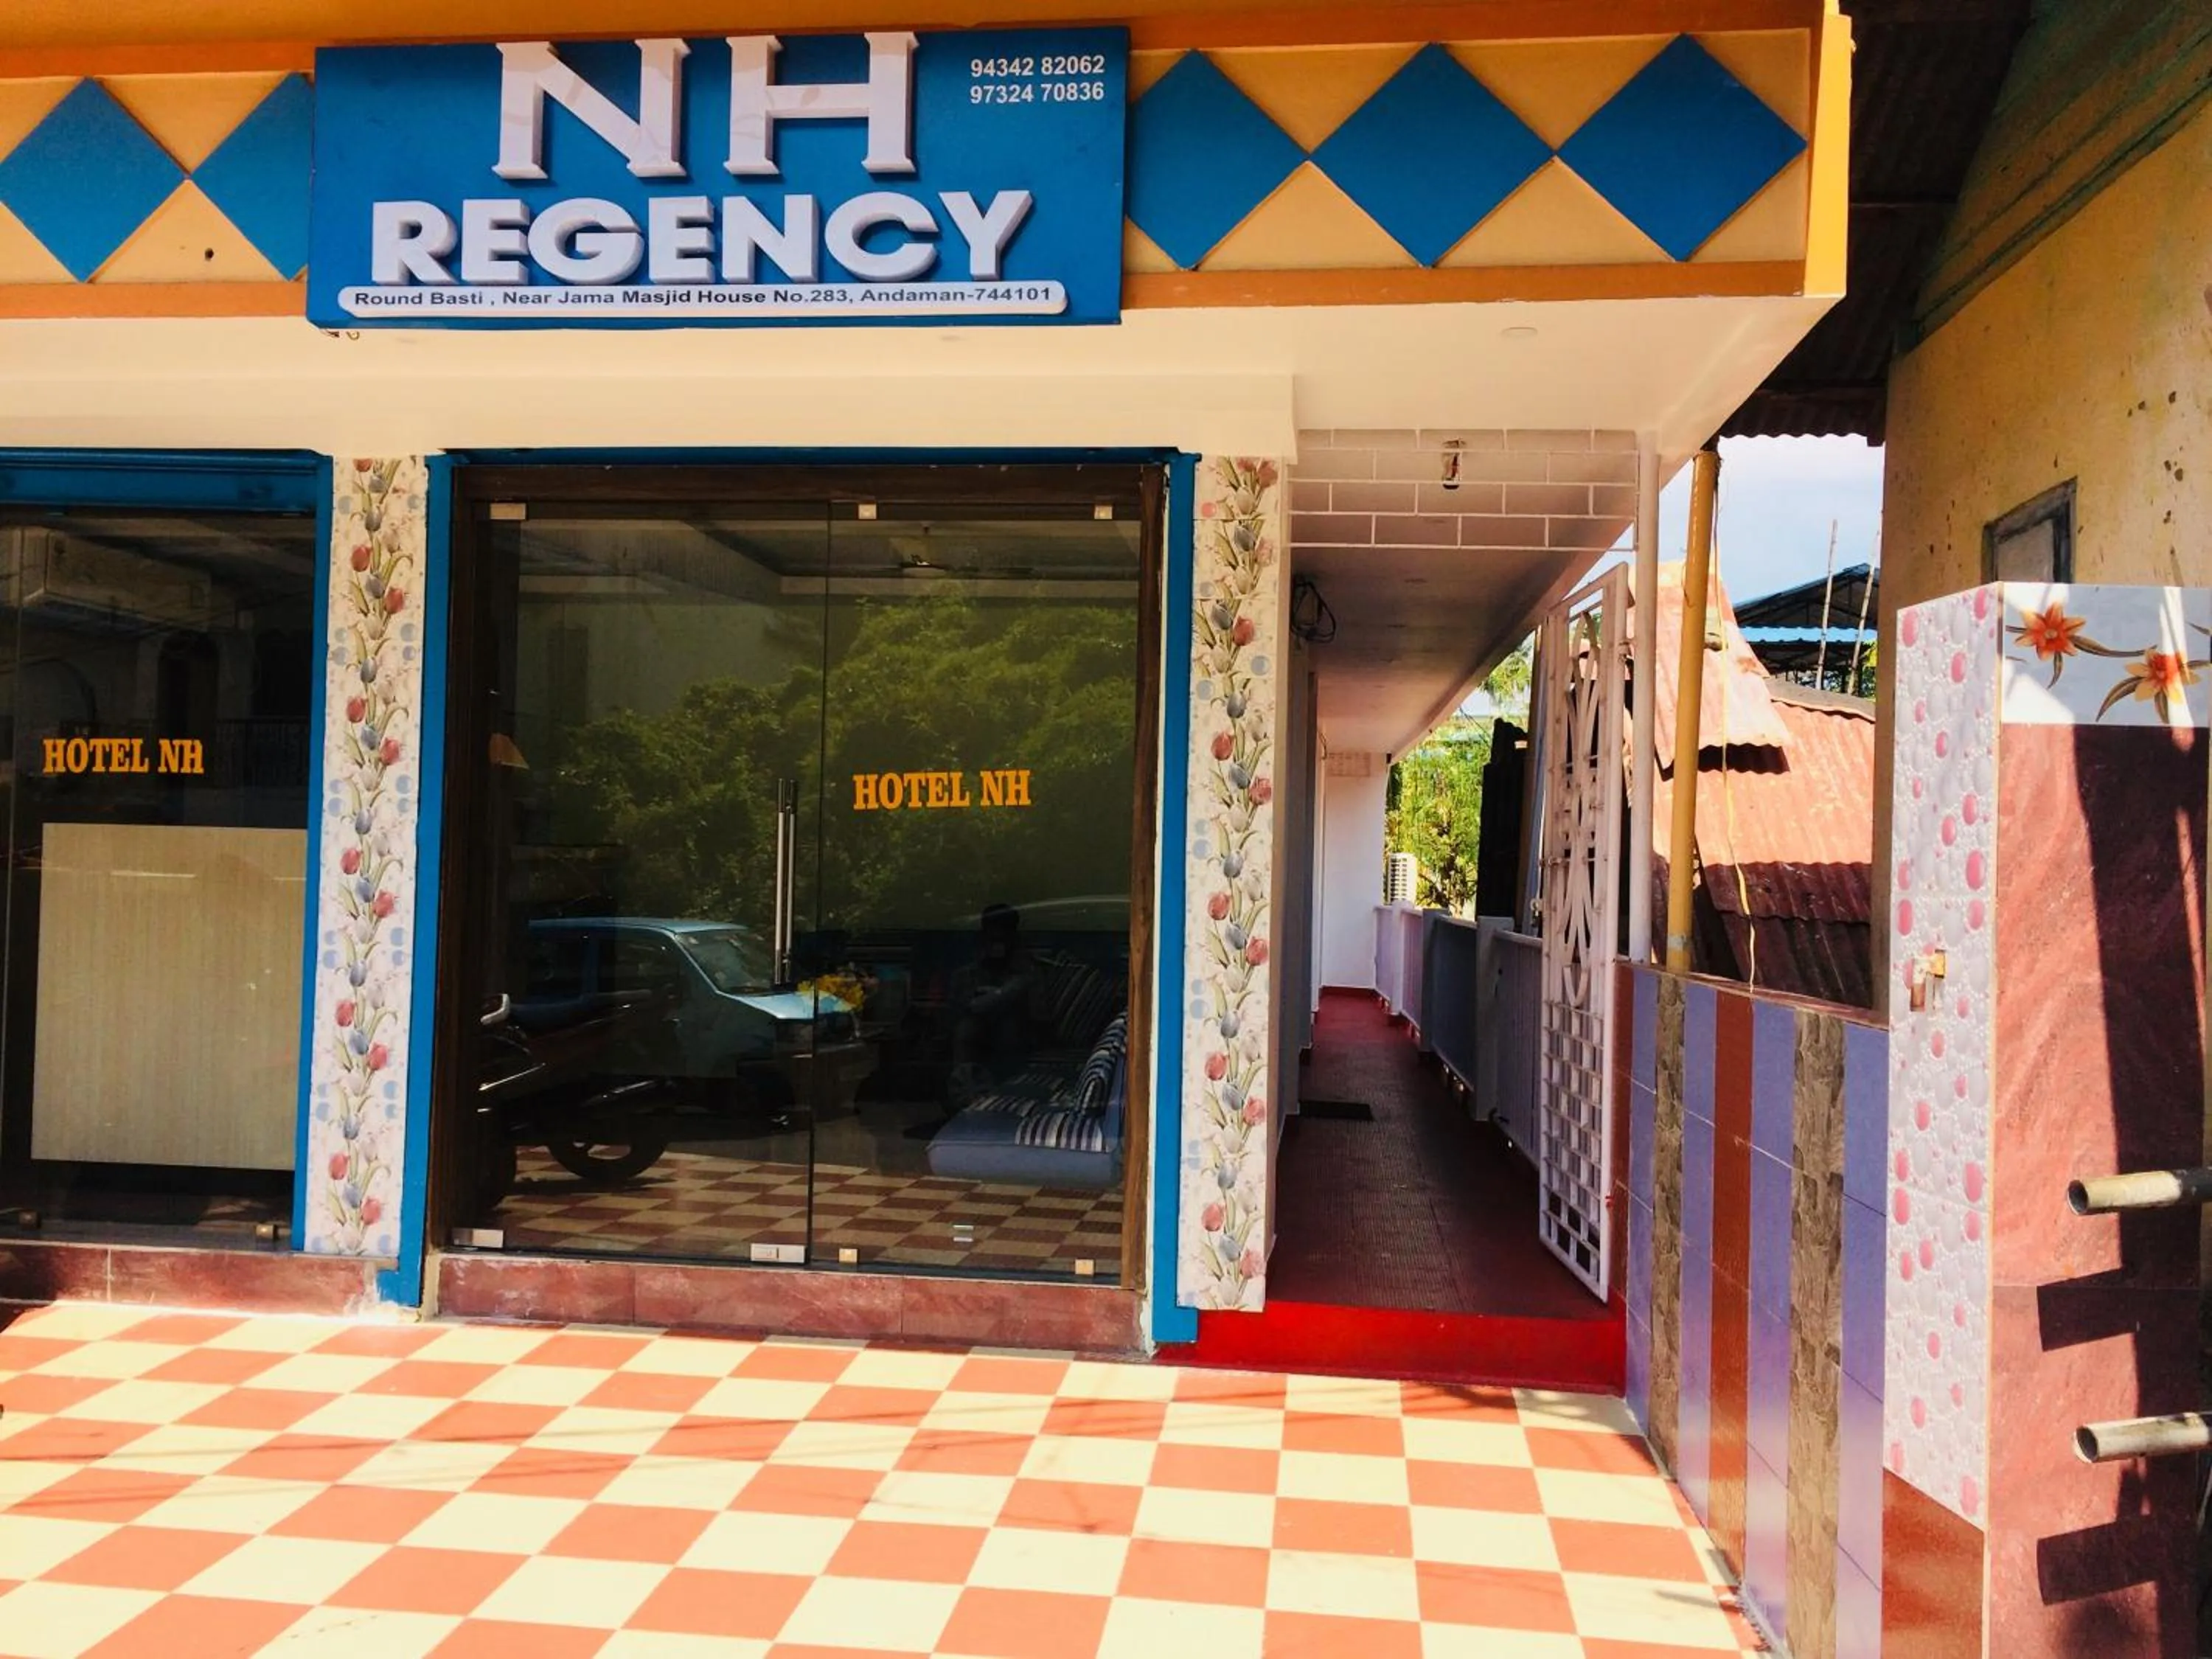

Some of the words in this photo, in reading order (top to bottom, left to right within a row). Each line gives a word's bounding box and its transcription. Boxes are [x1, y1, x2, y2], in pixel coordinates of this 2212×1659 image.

[970, 57, 1034, 77] 94342
[1040, 55, 1105, 75] 82062
[492, 32, 919, 179] NH
[970, 83, 1034, 104] 97324
[1040, 81, 1105, 102] 70836
[371, 189, 1033, 286] REGENCY
[355, 292, 423, 305] Round
[430, 291, 484, 305] Basti
[503, 291, 551, 305] Near
[557, 291, 615, 305] Jama
[622, 290, 692, 306] Masjid
[698, 290, 766, 304] House
[773, 289, 853, 304] No.283,
[860, 287, 1051, 302] Andaman-744101
[43, 737, 150, 773] HOTEL
[157, 738, 204, 774] NH
[852, 772, 970, 810] HOTEL
[980, 770, 1032, 807] NH
